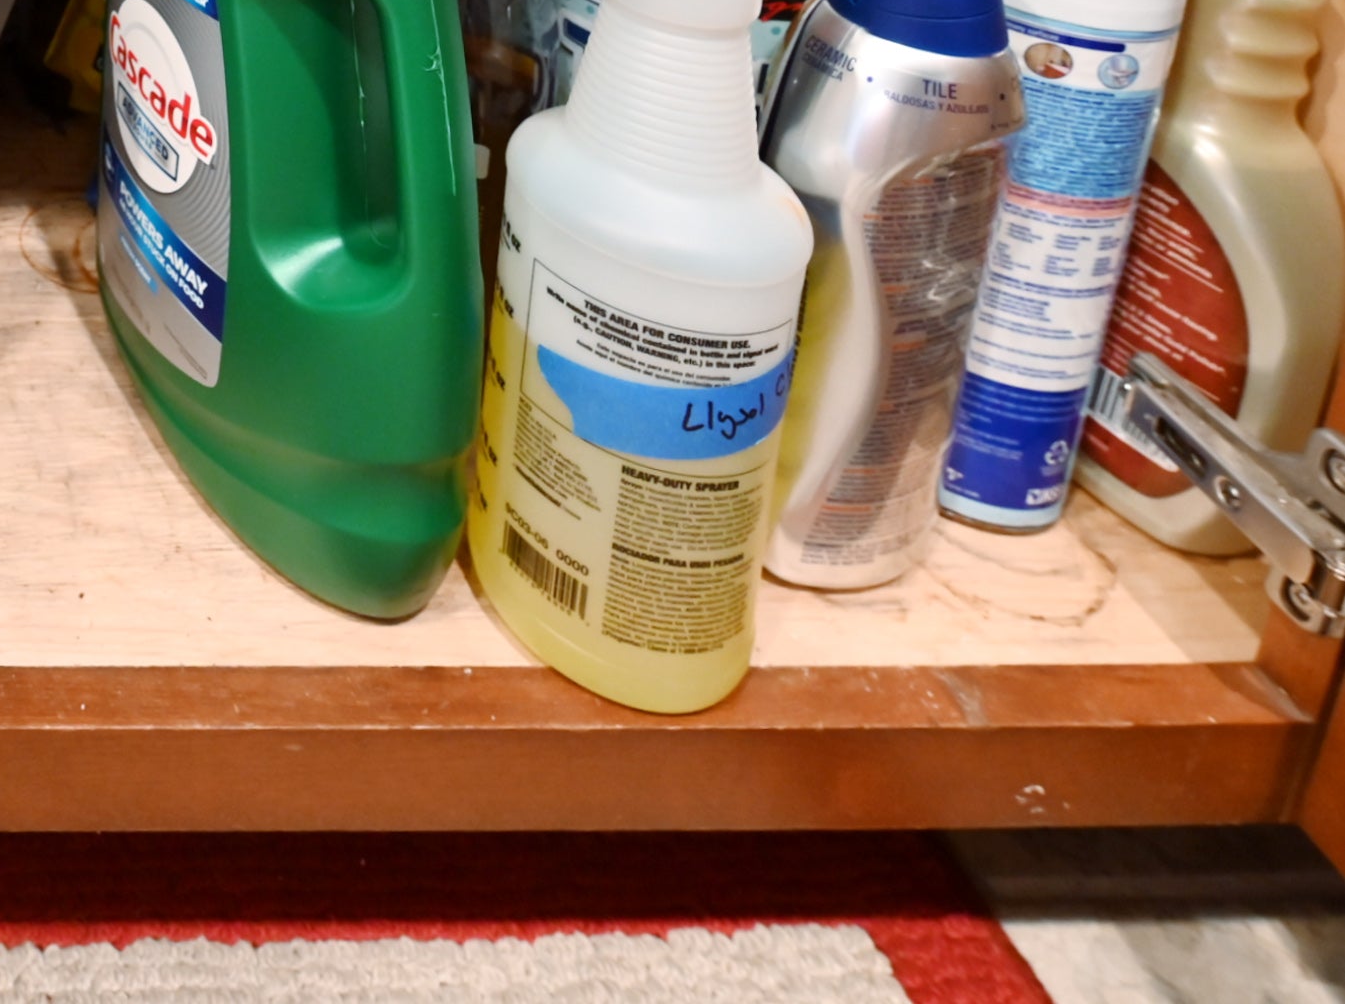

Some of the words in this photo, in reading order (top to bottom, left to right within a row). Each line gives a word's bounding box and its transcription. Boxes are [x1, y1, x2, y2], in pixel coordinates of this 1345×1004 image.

[110, 13, 214, 158] Cascade
[922, 78, 959, 100] TILE
[164, 244, 209, 296] AWAY
[584, 299, 607, 317] THIS
[609, 312, 640, 332] AREA
[642, 324, 665, 339] FOR
[668, 331, 729, 350] CONSUMER
[731, 338, 752, 350] USE.
[622, 465, 693, 492] HEAVY-DUTY
[695, 480, 740, 493] SPRAYER
